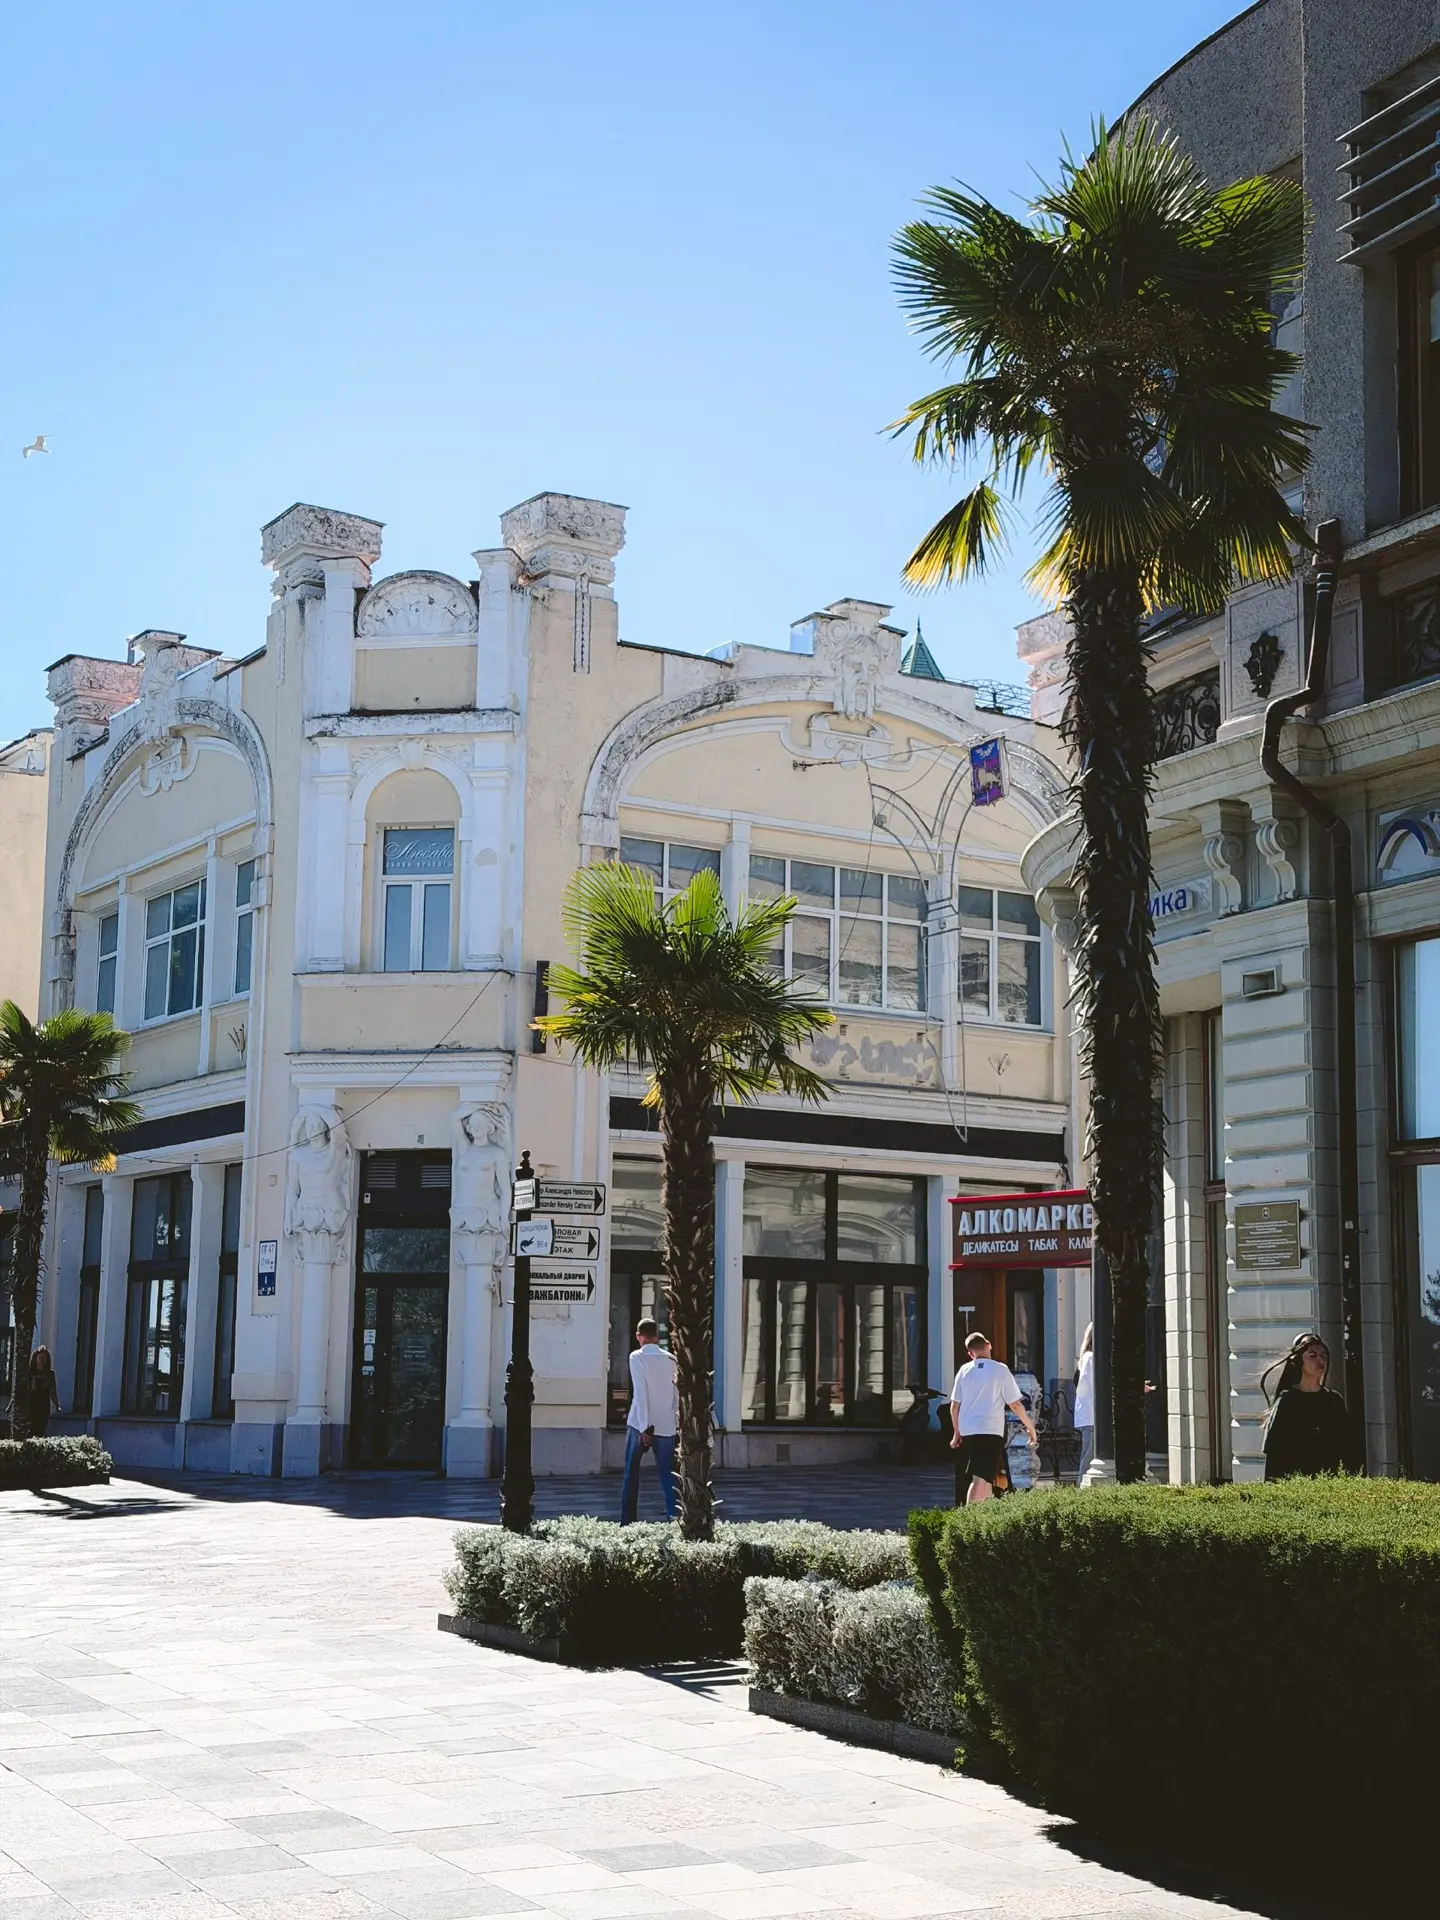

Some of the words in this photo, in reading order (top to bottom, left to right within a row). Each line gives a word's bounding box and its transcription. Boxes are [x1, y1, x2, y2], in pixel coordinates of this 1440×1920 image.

[385, 839, 454, 860] Любава
[1147, 888, 1187, 917] ика
[958, 1203, 1093, 1236] АЛКОМАРКЕ
[962, 1240, 1019, 1256] ДЕЛИКАТЕСЫ
[1028, 1238, 1058, 1251] ТАБАК
